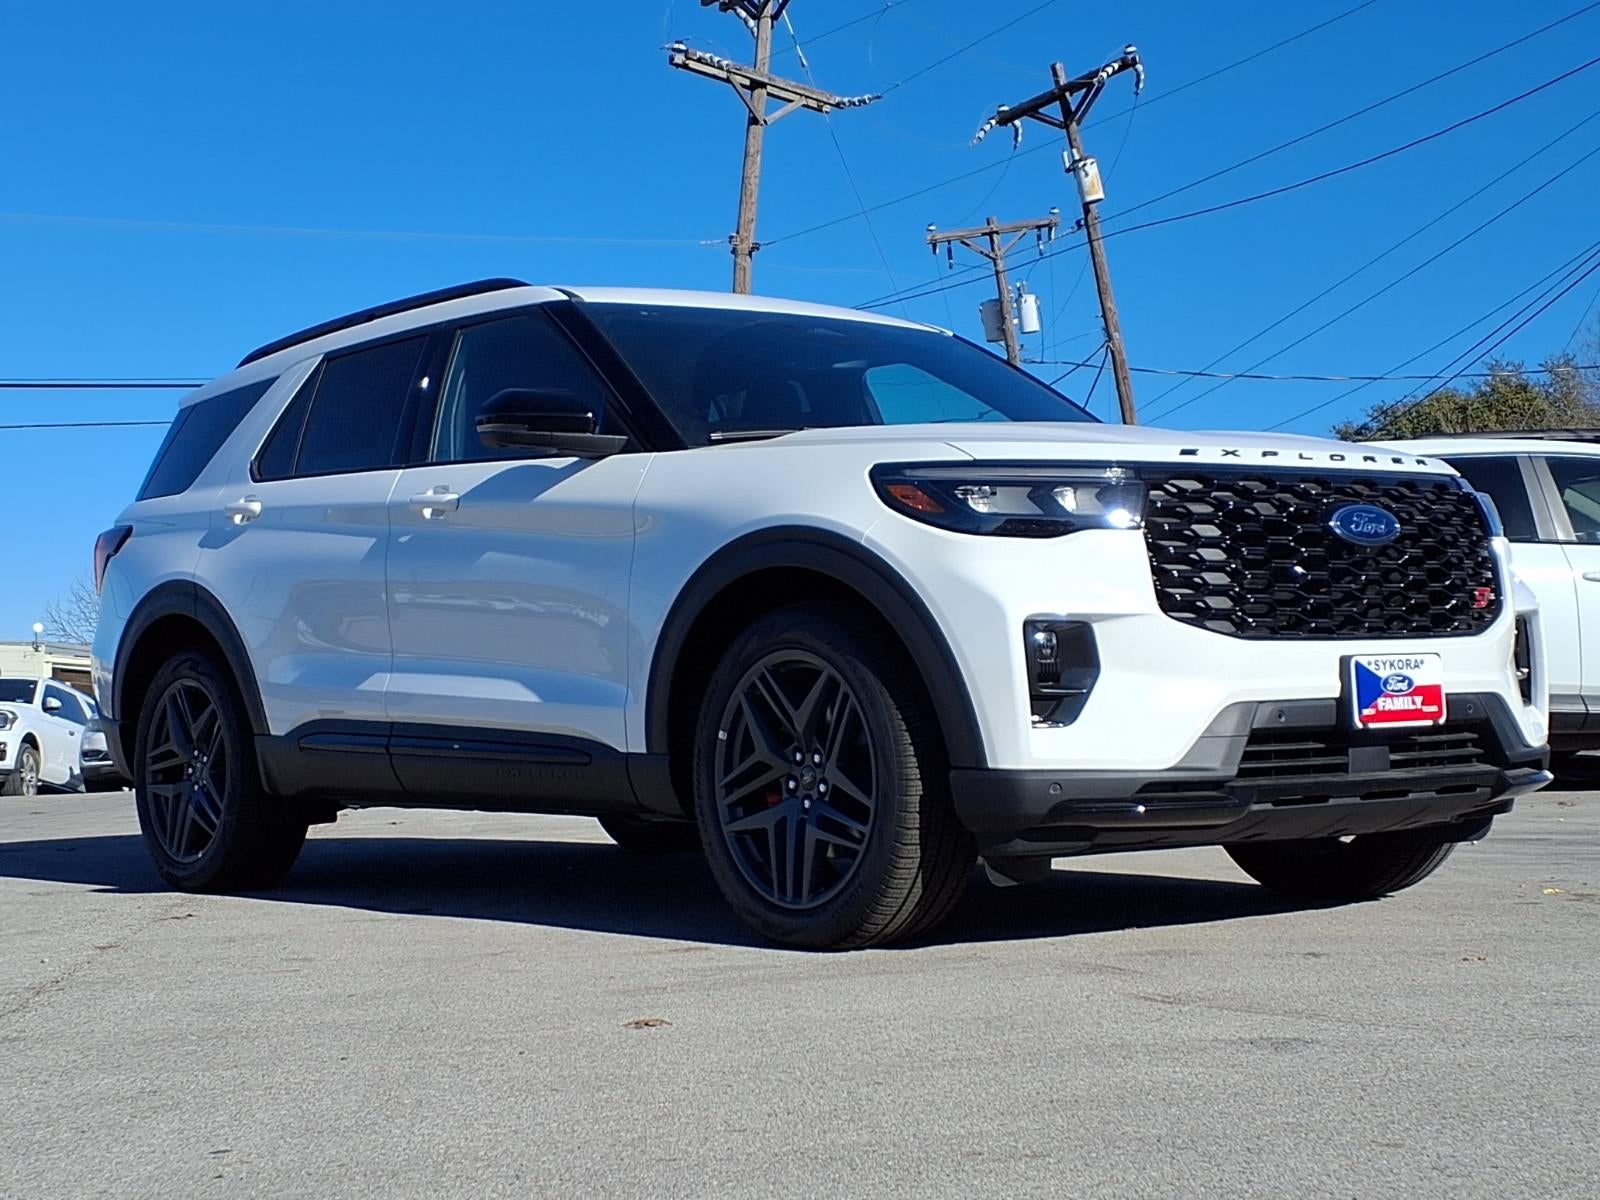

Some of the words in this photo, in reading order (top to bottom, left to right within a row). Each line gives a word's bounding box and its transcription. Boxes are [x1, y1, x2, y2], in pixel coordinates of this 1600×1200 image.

[1178, 448, 1429, 467] EXPLORER
[1350, 511, 1388, 535] Ford
[1374, 658, 1421, 671] SYKORA
[1385, 675, 1409, 691] Ford
[1377, 695, 1424, 711] FAMILY
